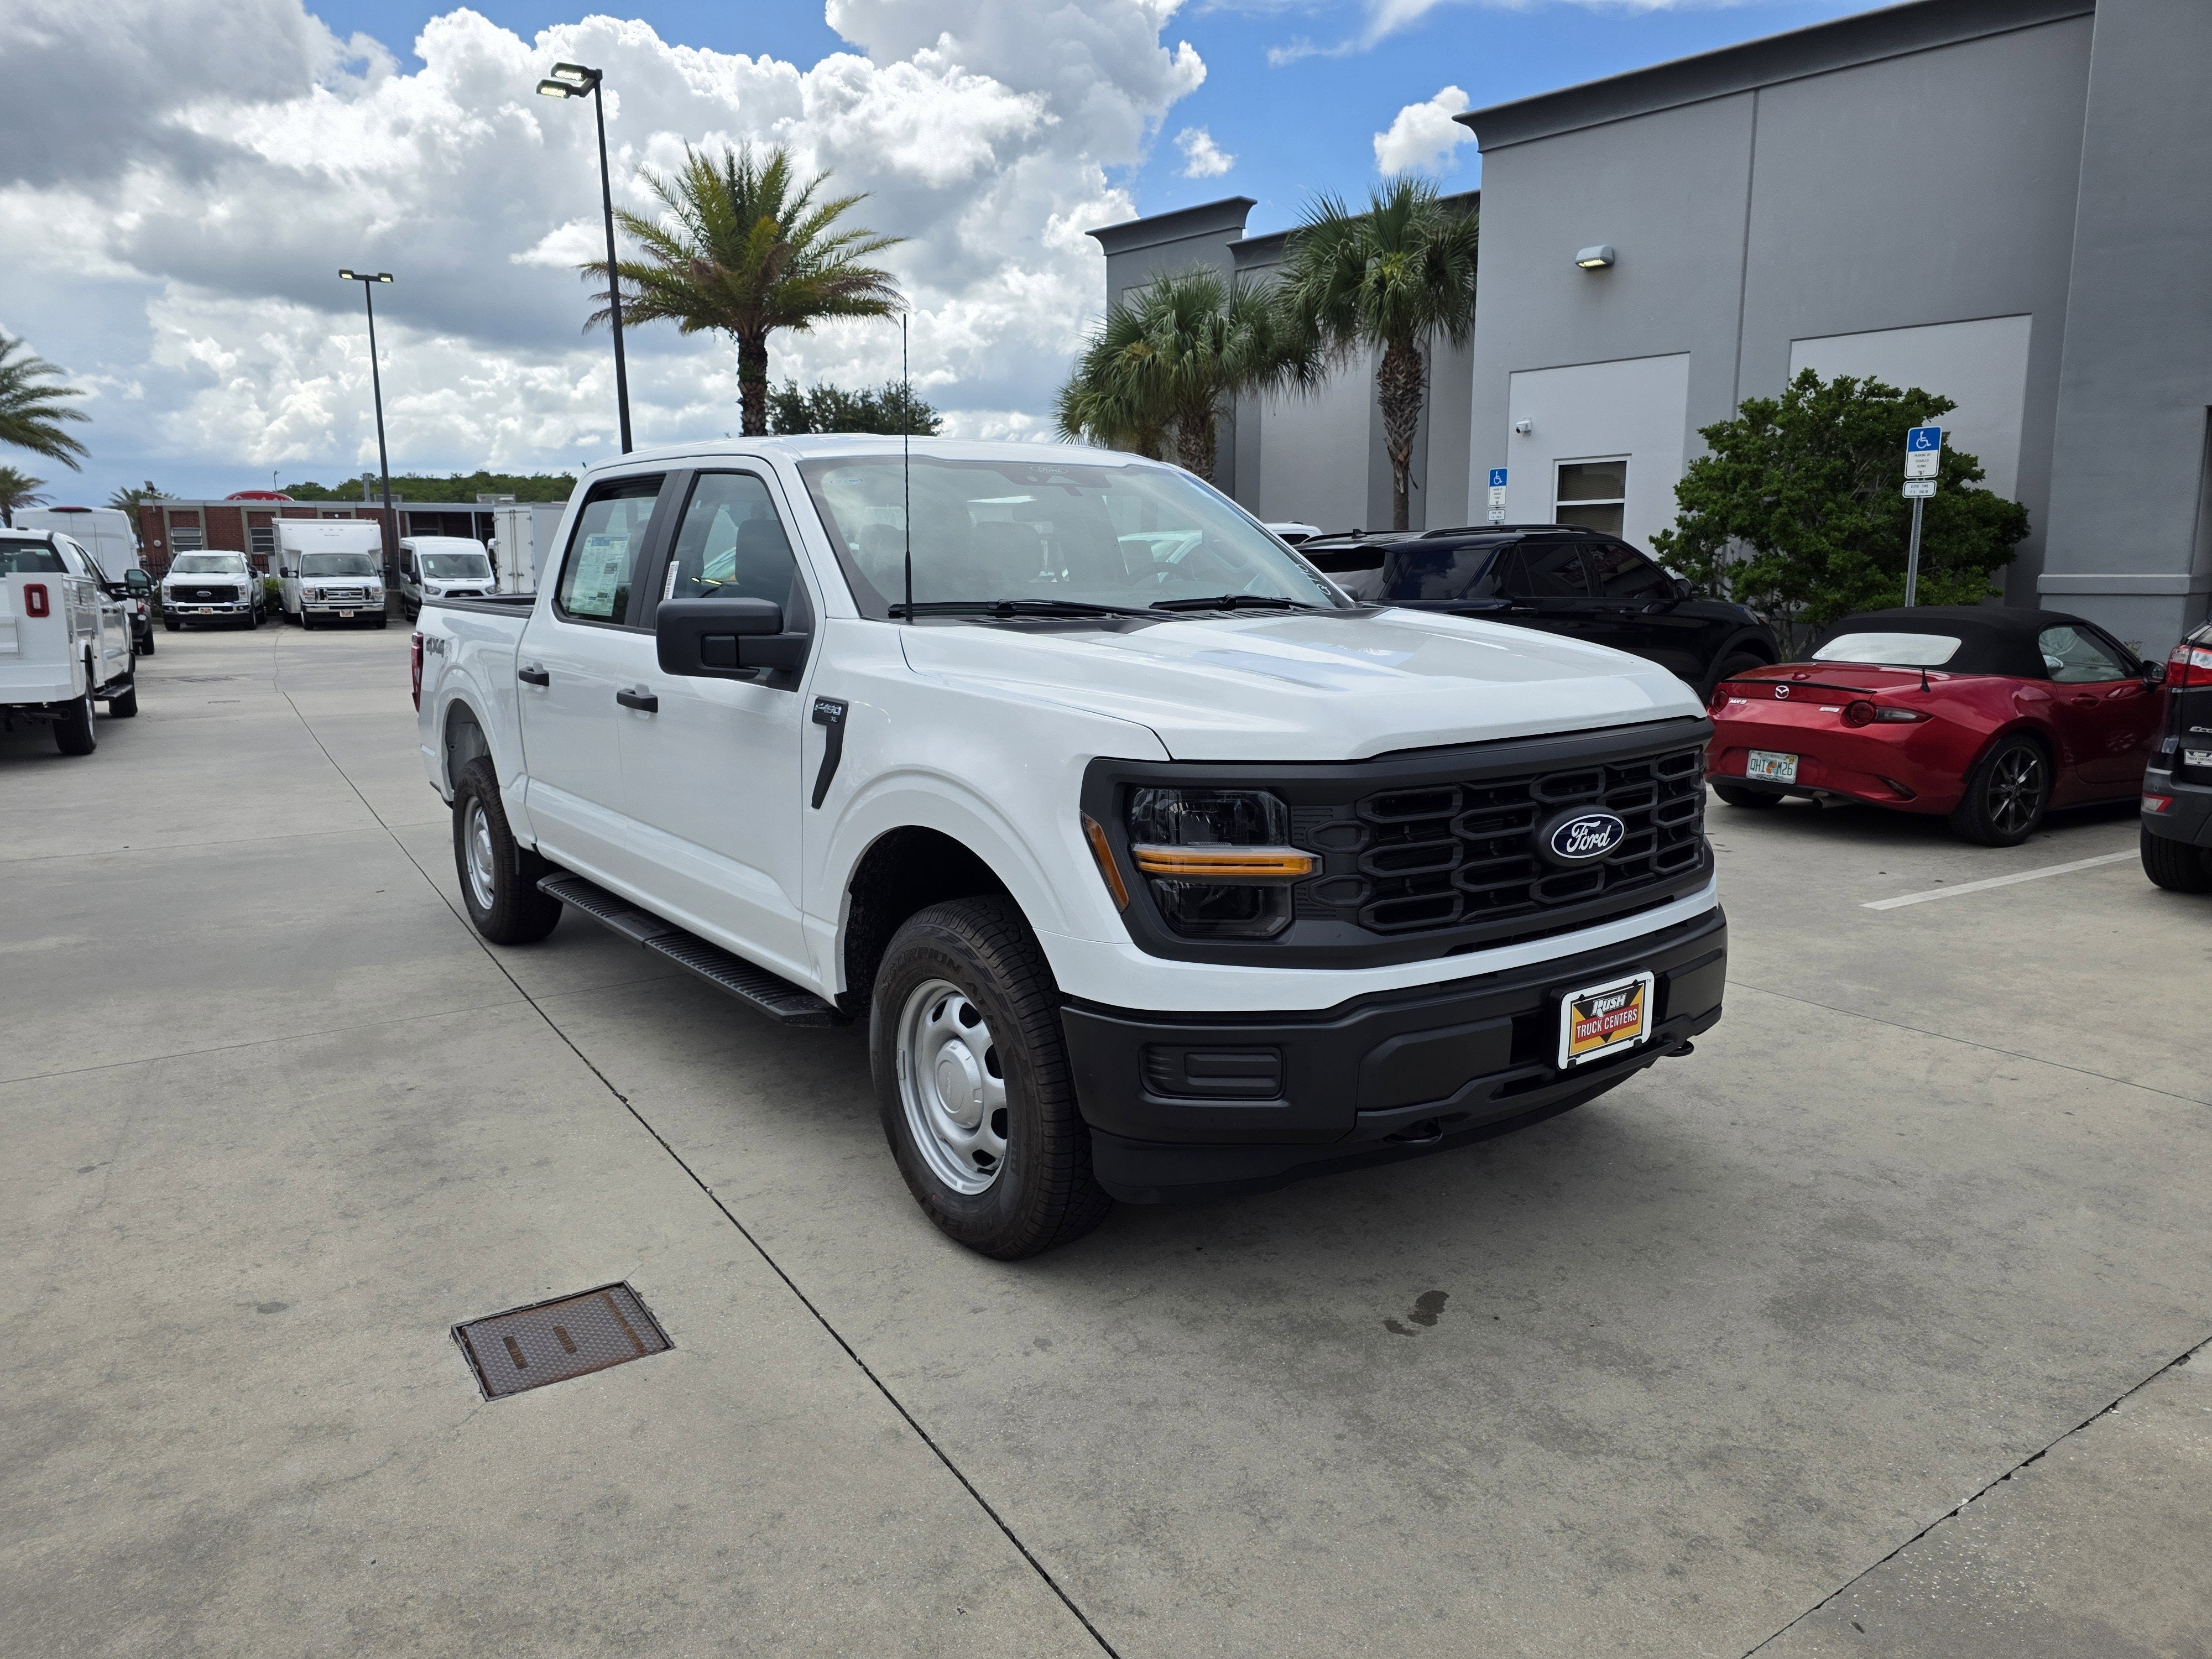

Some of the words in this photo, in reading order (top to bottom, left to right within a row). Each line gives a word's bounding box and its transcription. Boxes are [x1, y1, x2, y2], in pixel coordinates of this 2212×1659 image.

[814, 703, 841, 716] F-150
[1750, 758, 1766, 773] QHI
[1777, 761, 1793, 775] M26
[1566, 820, 1611, 853] Ford
[880, 946, 962, 996] SCORPION
[1590, 993, 1626, 1019] RUSH
[1577, 1019, 1602, 1039] TRUCK
[1604, 1008, 1637, 1030] CENTERS
